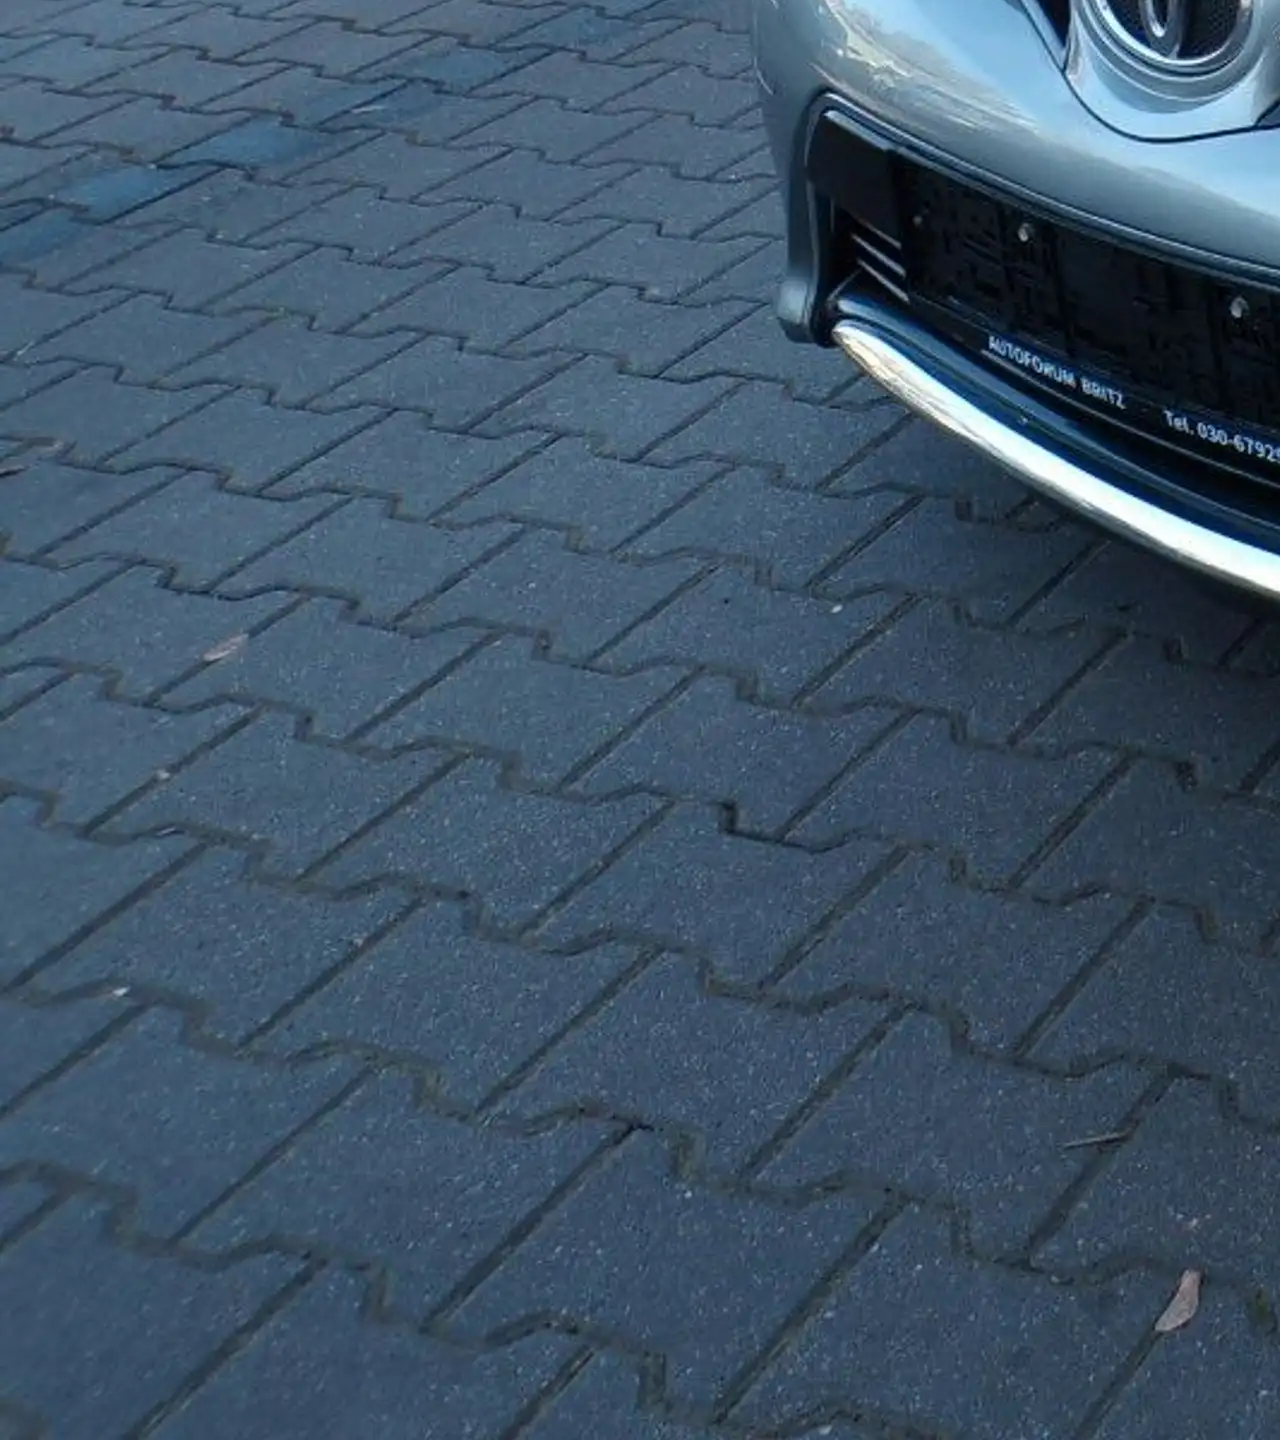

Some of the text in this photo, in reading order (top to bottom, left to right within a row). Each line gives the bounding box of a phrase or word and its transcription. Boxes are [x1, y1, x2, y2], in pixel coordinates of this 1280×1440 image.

[988, 335, 1078, 390] AUTOFORUM
[1079, 375, 1127, 410] BRITZ
[1163, 409, 1196, 436] Tel.
